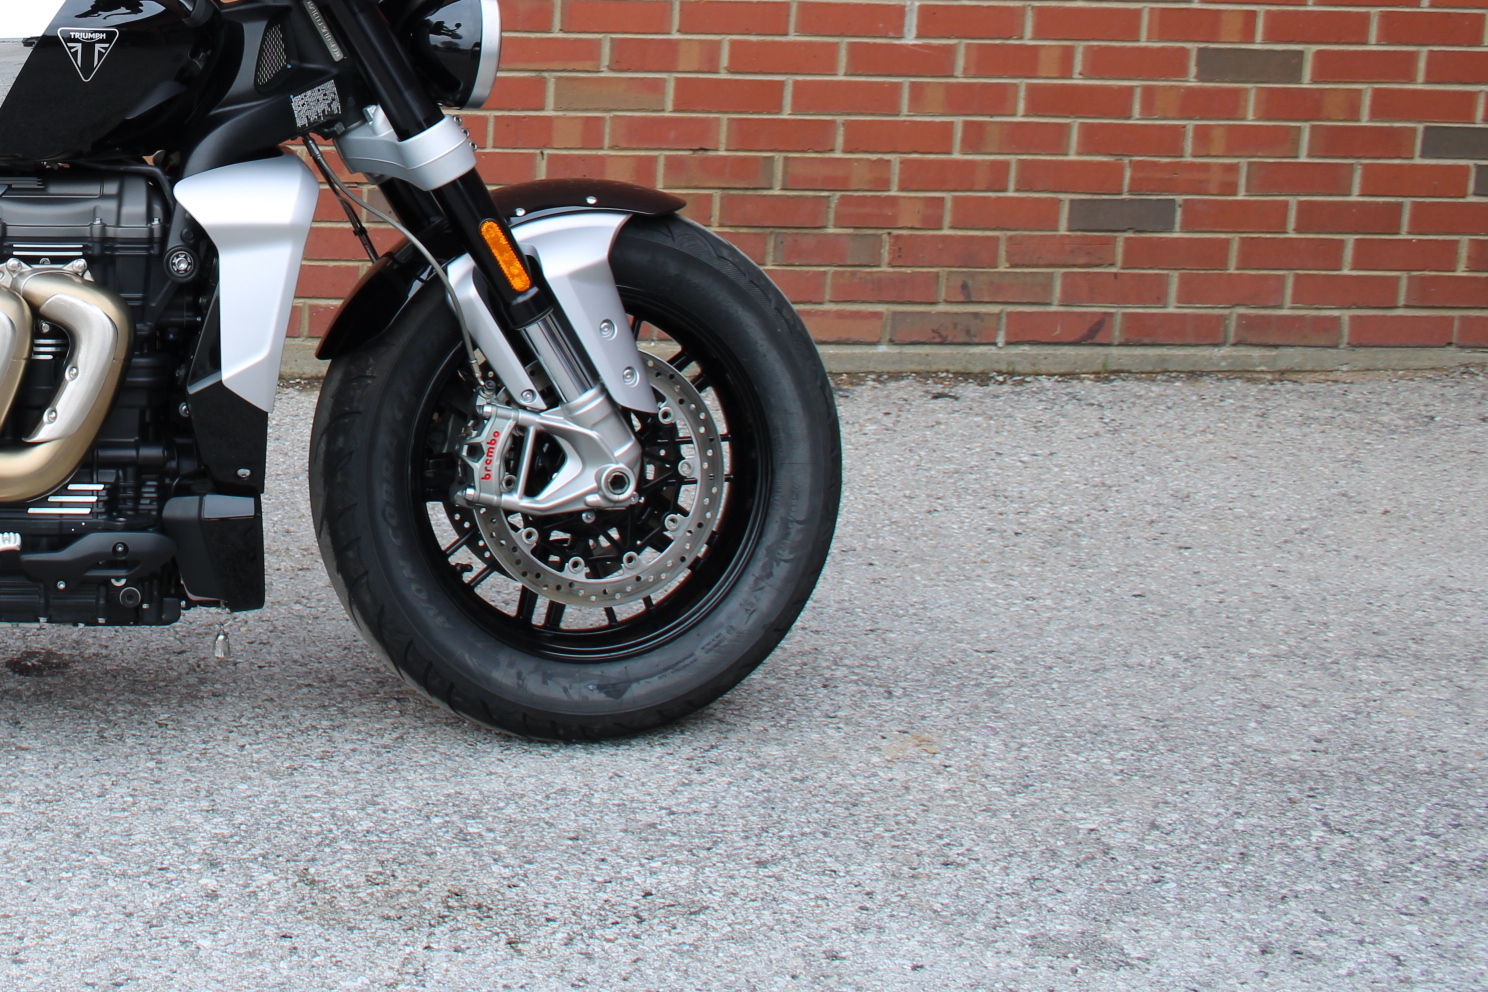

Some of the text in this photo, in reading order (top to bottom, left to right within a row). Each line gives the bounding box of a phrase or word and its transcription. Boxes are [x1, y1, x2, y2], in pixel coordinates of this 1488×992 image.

[69, 31, 106, 40] TRIUMPH
[481, 430, 500, 481] brembo
[398, 558, 456, 630] AVON
